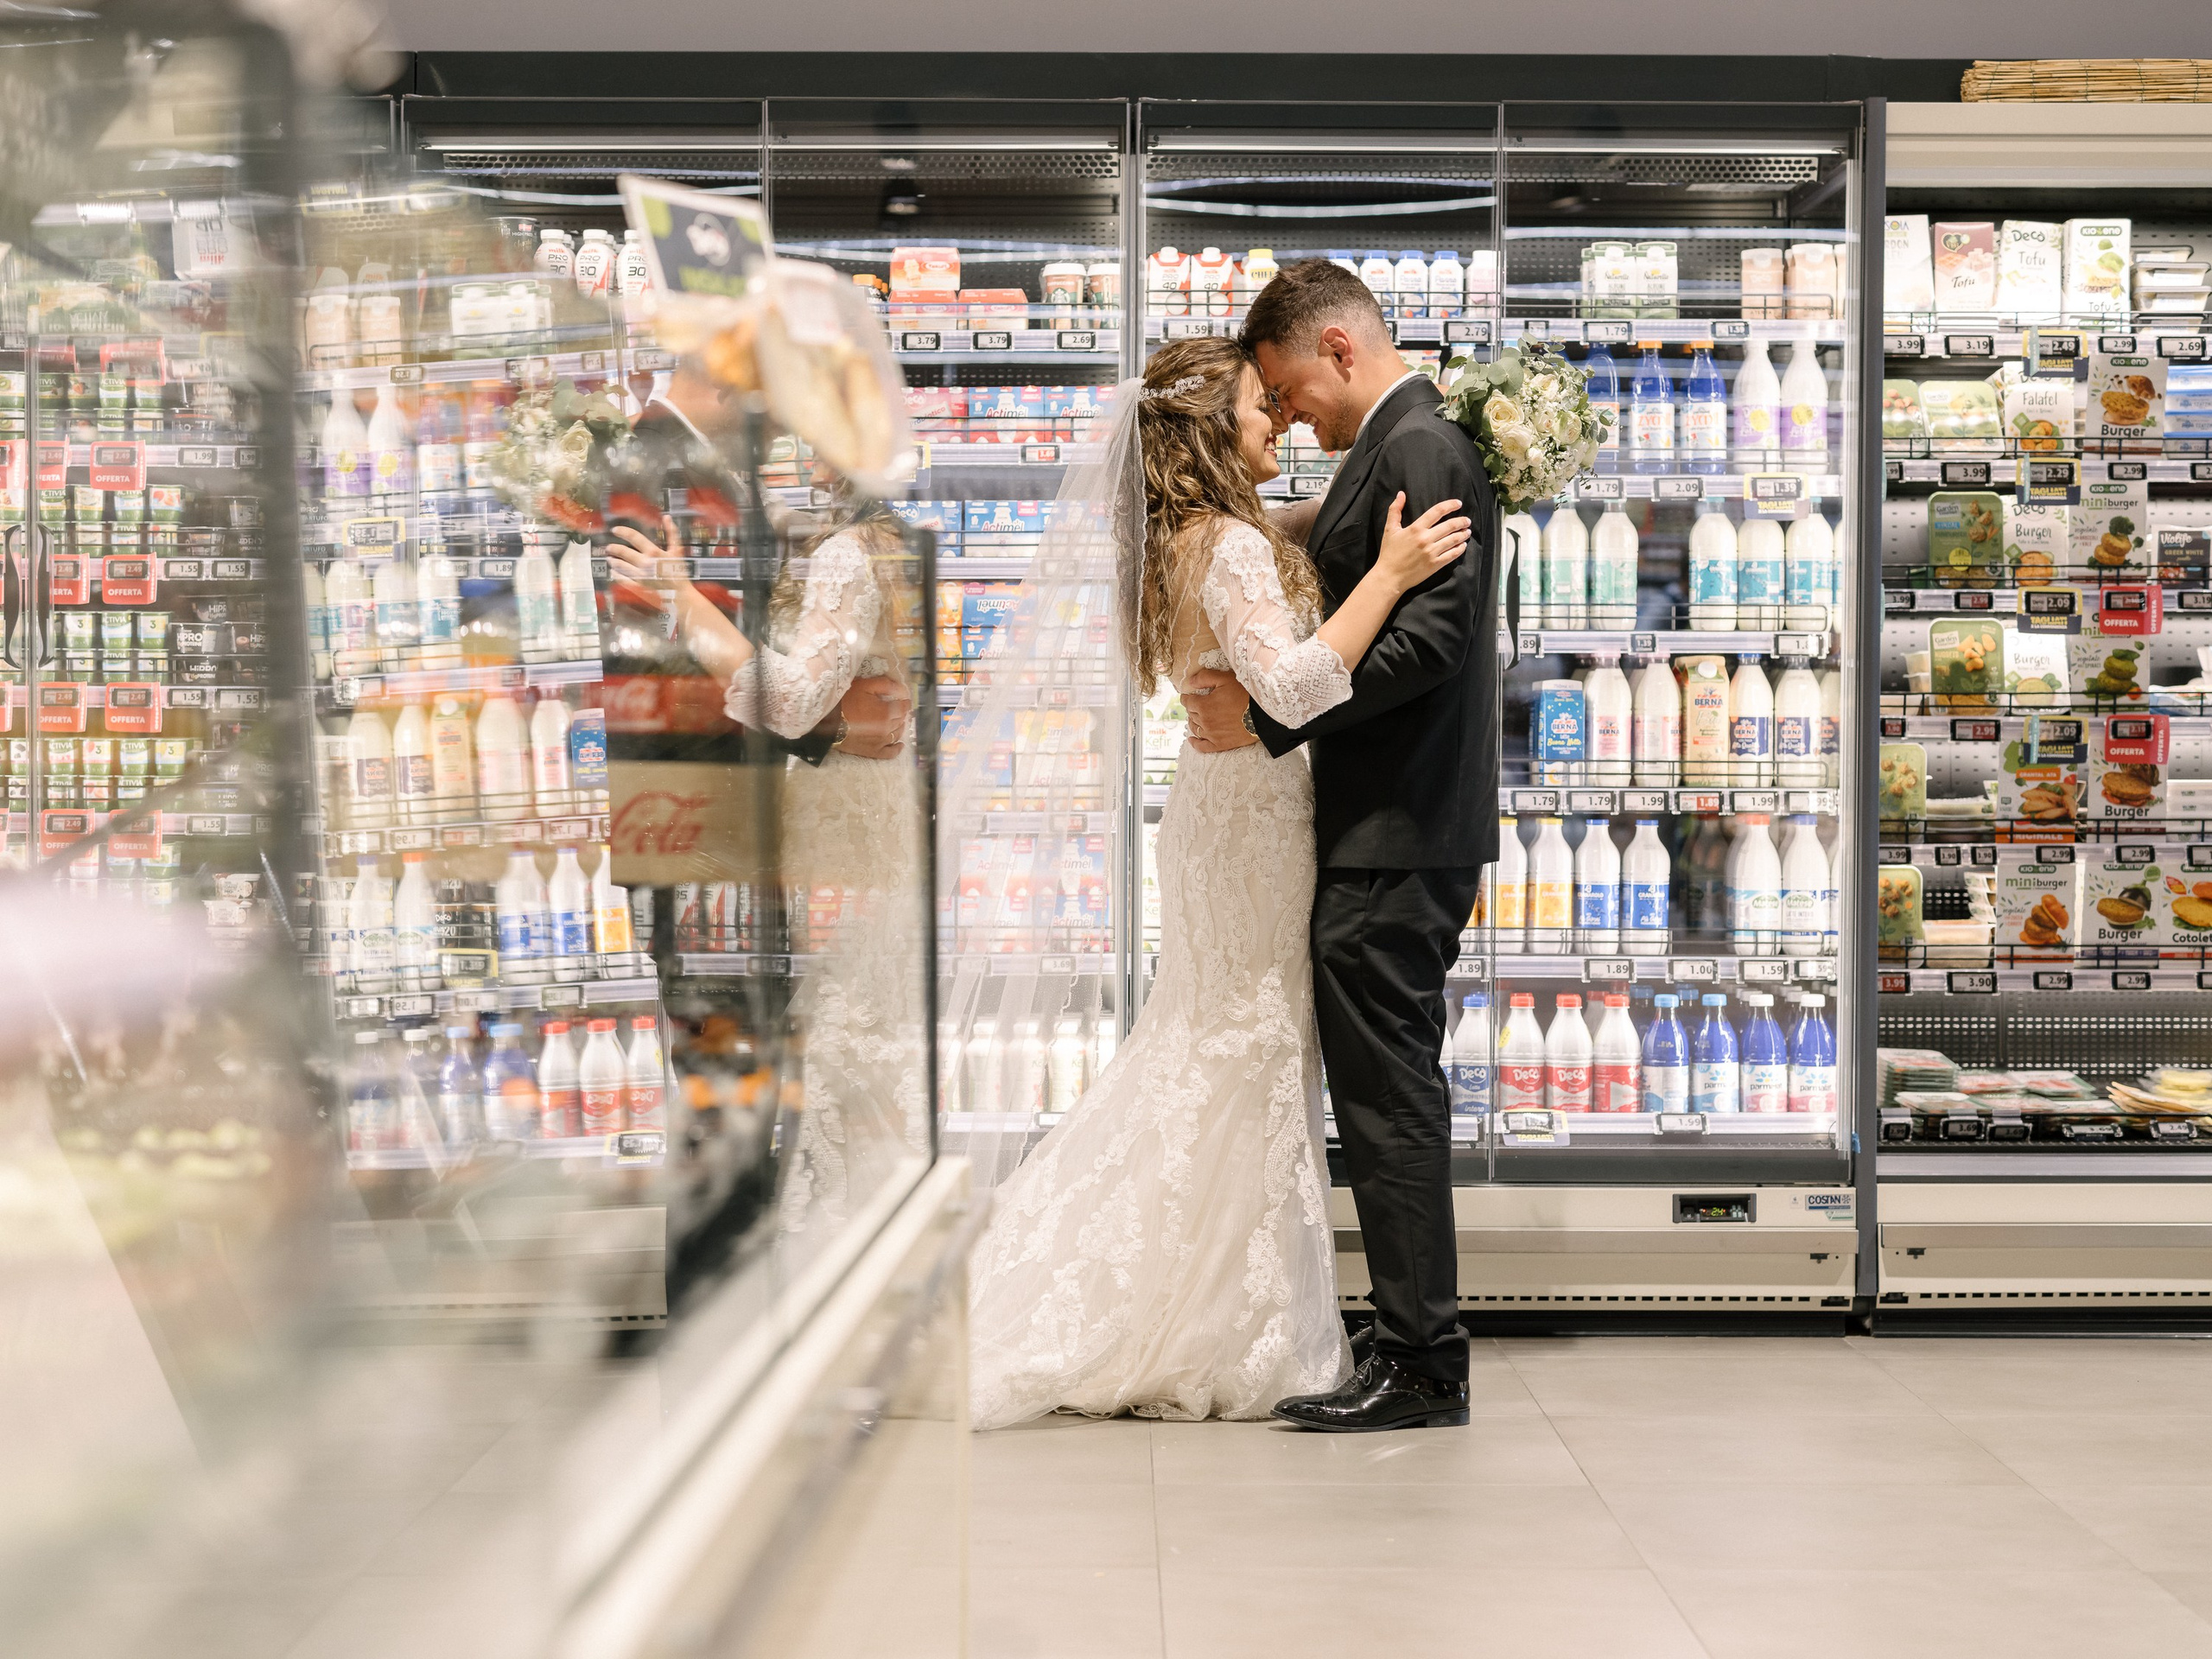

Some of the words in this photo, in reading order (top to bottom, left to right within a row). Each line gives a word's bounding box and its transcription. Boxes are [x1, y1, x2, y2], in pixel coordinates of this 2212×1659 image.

[2018, 251, 2046, 265] Tofu
[628, 266, 646, 276] 30
[1951, 276, 1975, 289] Tofu
[2088, 302, 2111, 312] Tofu
[1185, 325, 1207, 334] 1.59
[1465, 327, 1487, 336] 2.79
[1605, 327, 1627, 336] 1.79
[1897, 340, 1920, 349] 3.99
[1966, 340, 1988, 350] 3.19
[2052, 341, 2075, 351] 2.49
[2178, 342, 2202, 351] 2.69
[2023, 391, 2058, 405] Falafel
[986, 406, 1028, 418] Actimel
[2101, 425, 2146, 438] Burger
[1962, 468, 1986, 477] 3.99
[2047, 468, 2069, 477] 2.29
[1596, 483, 1618, 493] 1.79
[1675, 483, 1698, 493] 2.09
[1774, 482, 1796, 493] 1.39
[982, 521, 1024, 531] Actimel
[2015, 524, 2052, 539] Burger
[2160, 532, 2192, 547] Violife
[2048, 599, 2070, 607] 2.09
[78, 620, 84, 628] 3
[150, 620, 156, 629] 3
[2104, 619, 2139, 627] OFFERTA
[1520, 639, 1535, 648] .89
[2014, 653, 2050, 666] Burger
[237, 695, 258, 703] 1.55
[2054, 727, 2076, 736] 2.09
[1145, 735, 1171, 748] Kefir
[1533, 797, 1554, 805] 1.79
[1589, 797, 1611, 805] 1.79
[1642, 797, 1663, 805] 1.99
[1699, 798, 1719, 806] 1.89
[1751, 797, 1774, 806] 1.99
[2105, 805, 2150, 819] Burger
[2005, 878, 2067, 890] miniburger
[2099, 929, 2143, 942] Burger
[1459, 963, 1481, 973] 1.89
[1606, 964, 1629, 974] 1.89
[1690, 965, 1713, 975] 1.00
[1761, 965, 1783, 975] 1.59
[1885, 978, 1905, 988] 3.99
[1968, 977, 1992, 988] 3.90
[1808, 1195, 1841, 1205] COSTAN
